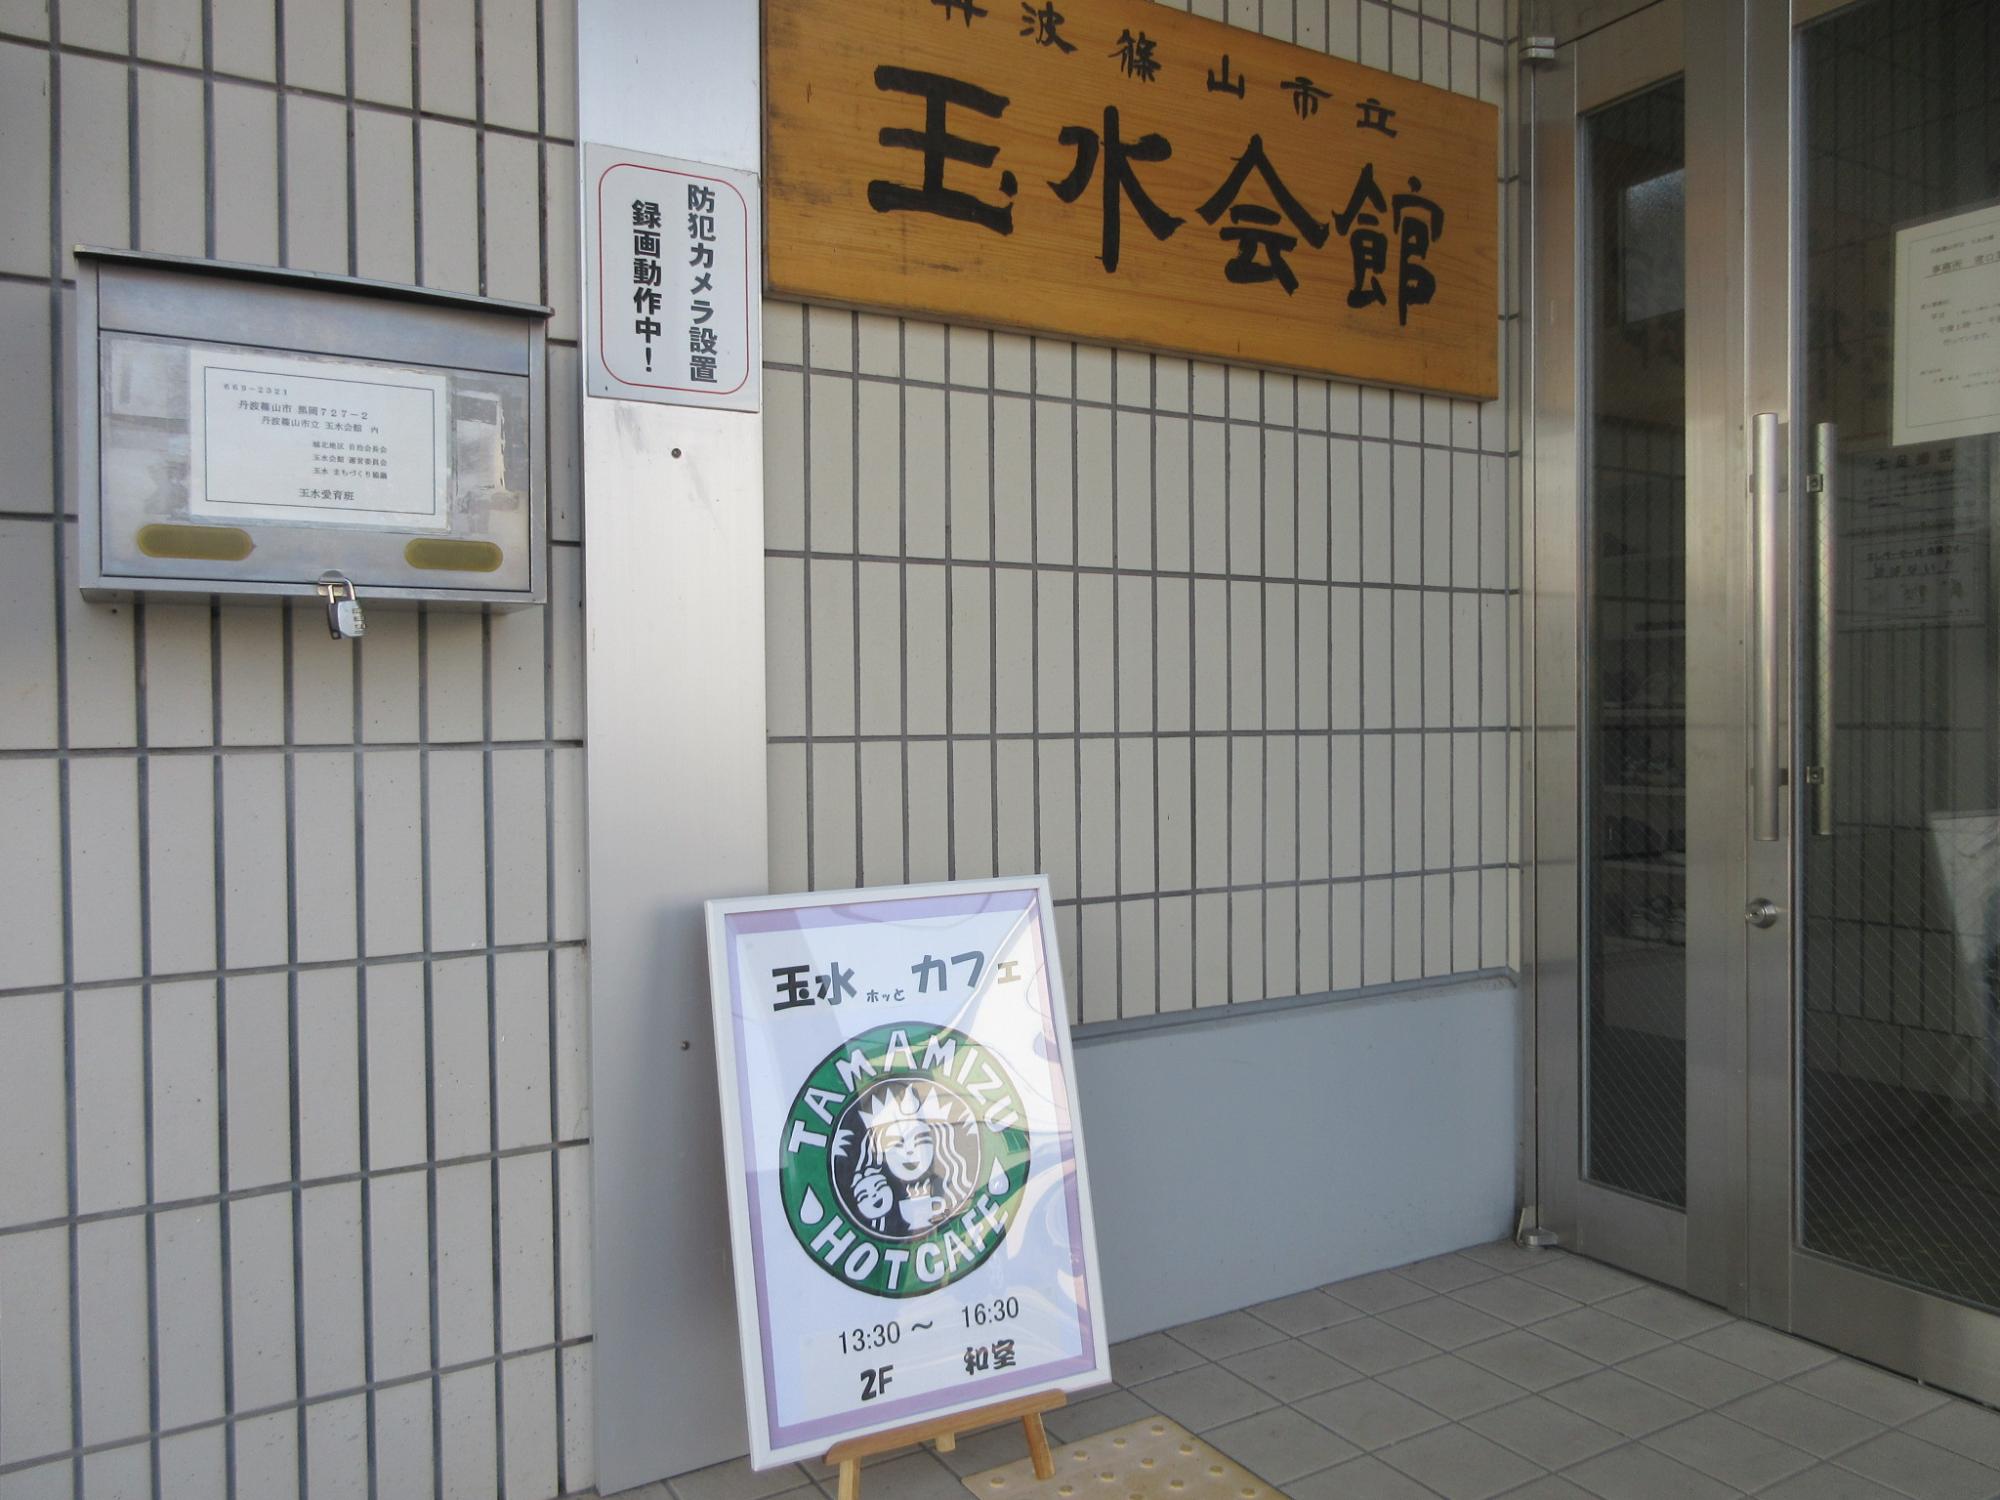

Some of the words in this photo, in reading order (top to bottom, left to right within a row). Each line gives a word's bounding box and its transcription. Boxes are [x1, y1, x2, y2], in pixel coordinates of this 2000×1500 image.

[867, 64, 1445, 326] 玉水会館
[631, 199, 662, 373] 録画動作中!
[687, 183, 718, 384] 防犯カメラ設置
[772, 961, 858, 1012] 玉水
[866, 989, 906, 1003] ホッと
[911, 950, 1022, 994] カフェ
[788, 1029, 1020, 1153] TAMAMIZU
[838, 1321, 901, 1355] 13:30
[961, 1296, 1020, 1328] 16:30
[860, 1364, 895, 1401] 2F
[963, 1339, 1017, 1375] 和室
